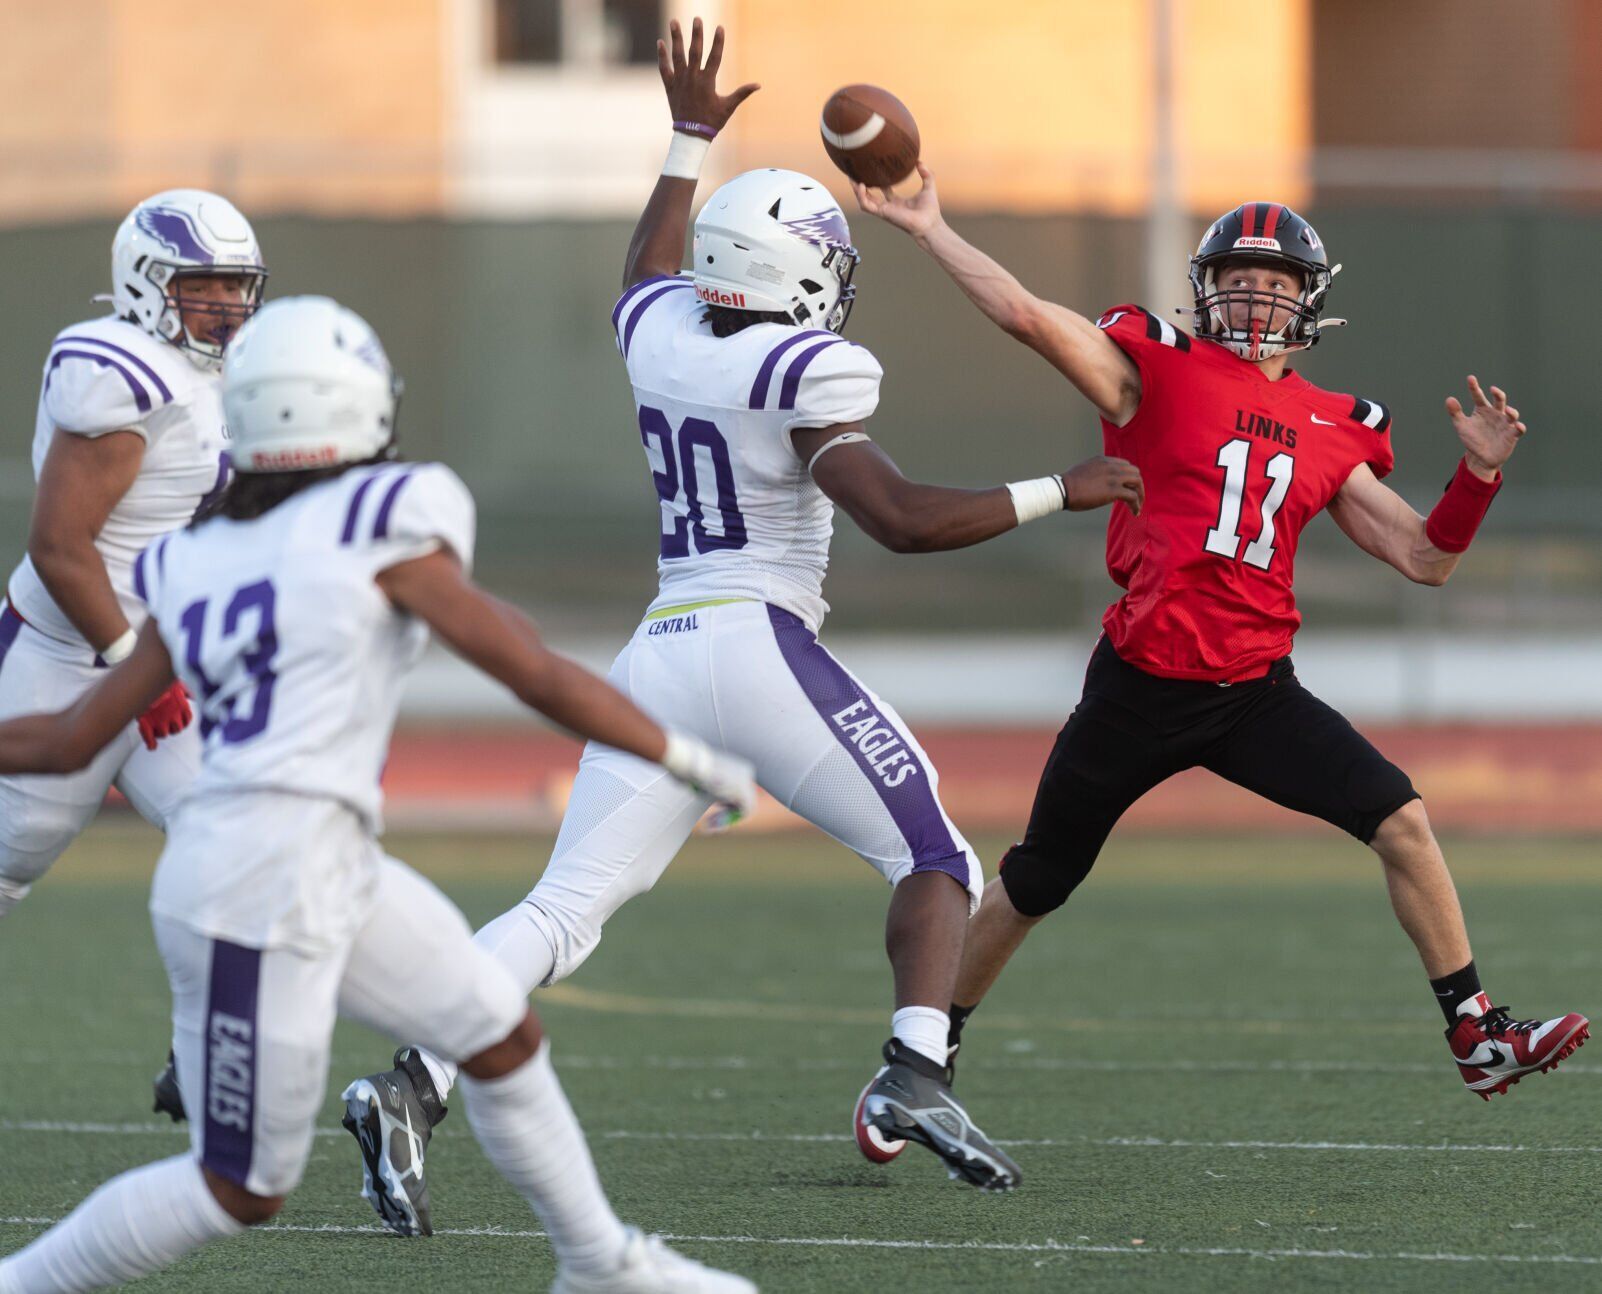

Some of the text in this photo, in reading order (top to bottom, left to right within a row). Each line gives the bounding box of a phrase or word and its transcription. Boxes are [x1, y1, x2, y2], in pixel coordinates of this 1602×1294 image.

[638, 404, 749, 560] 20
[1236, 410, 1297, 449] LINKS
[1203, 437, 1295, 573] 11
[179, 577, 278, 746] 13
[648, 613, 699, 635] CENTRAL
[832, 699, 917, 788] EAGLES
[209, 1012, 252, 1132] EAGLES
